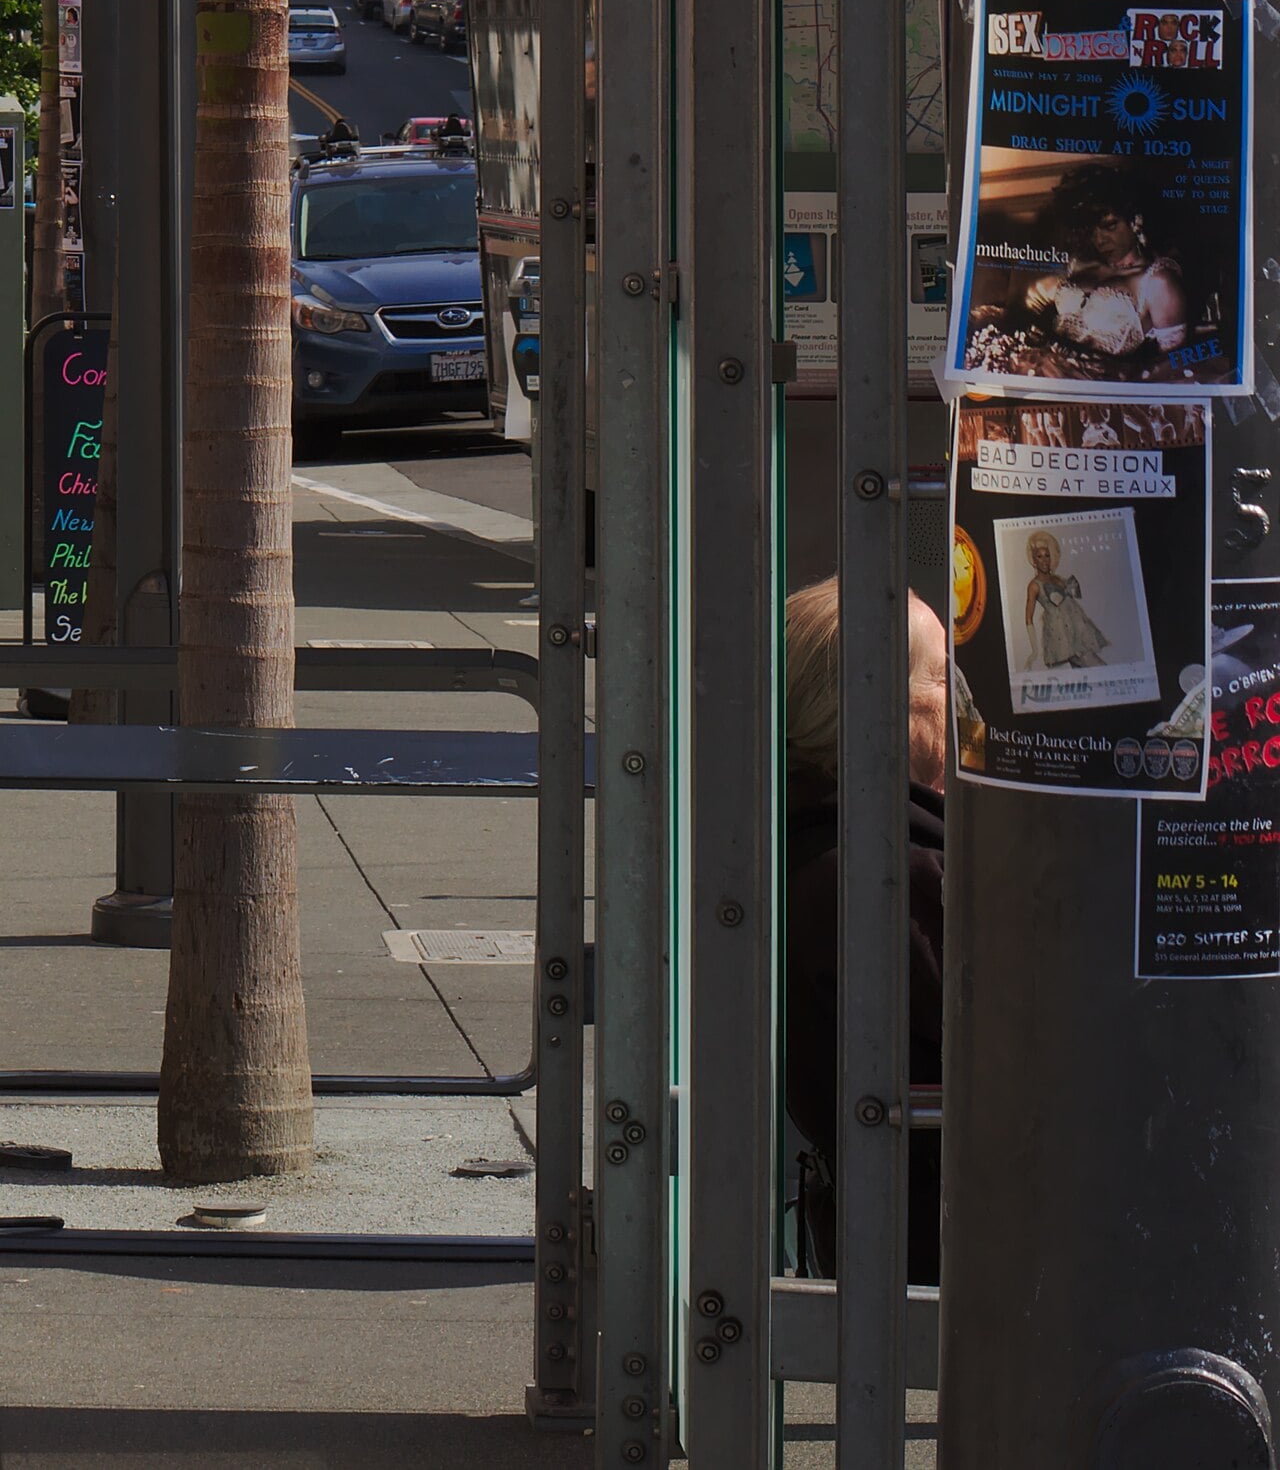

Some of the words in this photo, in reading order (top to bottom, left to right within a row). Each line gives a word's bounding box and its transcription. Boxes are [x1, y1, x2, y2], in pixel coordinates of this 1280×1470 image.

[988, 12, 1043, 56] SEX
[1043, 32, 1130, 60] DRAGS
[1133, 12, 1222, 44] ROCK
[1143, 40, 1221, 69] ROLL
[993, 69, 1035, 81] SATURDAY
[1040, 72, 1059, 82] MAY
[989, 89, 1102, 120] MIDNIGHT
[1172, 97, 1227, 122] SUN
[1011, 134, 1048, 151] DRAG
[1056, 137, 1103, 154] SHOW
[1111, 139, 1133, 155] AT
[1143, 139, 1192, 157] 10:30
[1187, 158, 1197, 170] A
[1200, 158, 1231, 170] NIGHT
[1192, 175, 1231, 186] QUEENS
[1162, 191, 1184, 200] NEW
[788, 209, 823, 225] Opens
[1199, 205, 1229, 215] STAGE
[975, 241, 1070, 265] muthachucka
[1167, 337, 1224, 370] FREE
[432, 359, 485, 381] 7HGF795
[980, 444, 1018, 466] BAD
[1030, 451, 1159, 474] DECISION
[972, 473, 1048, 493] MONDAYS
[1059, 478, 1085, 493] AT
[1097, 479, 1173, 494] BEAUX
[51, 508, 95, 532] New
[49, 578, 79, 605] The
[990, 726, 1010, 743] Best
[1011, 729, 1035, 749] Gay
[1036, 732, 1079, 750] Dance
[1078, 735, 1113, 752] Club
[1033, 750, 1090, 763] MARKET
[1156, 819, 1227, 833] Experience
[1229, 819, 1250, 831] the
[1252, 817, 1273, 830] live
[1156, 833, 1218, 847] musical...
[1157, 873, 1192, 889] MAY
[1195, 874, 1206, 889] 5
[1220, 874, 1239, 888] 14
[1156, 933, 1187, 946] 620
[1194, 931, 1249, 946] SUTTER
[1255, 929, 1273, 944] ST
